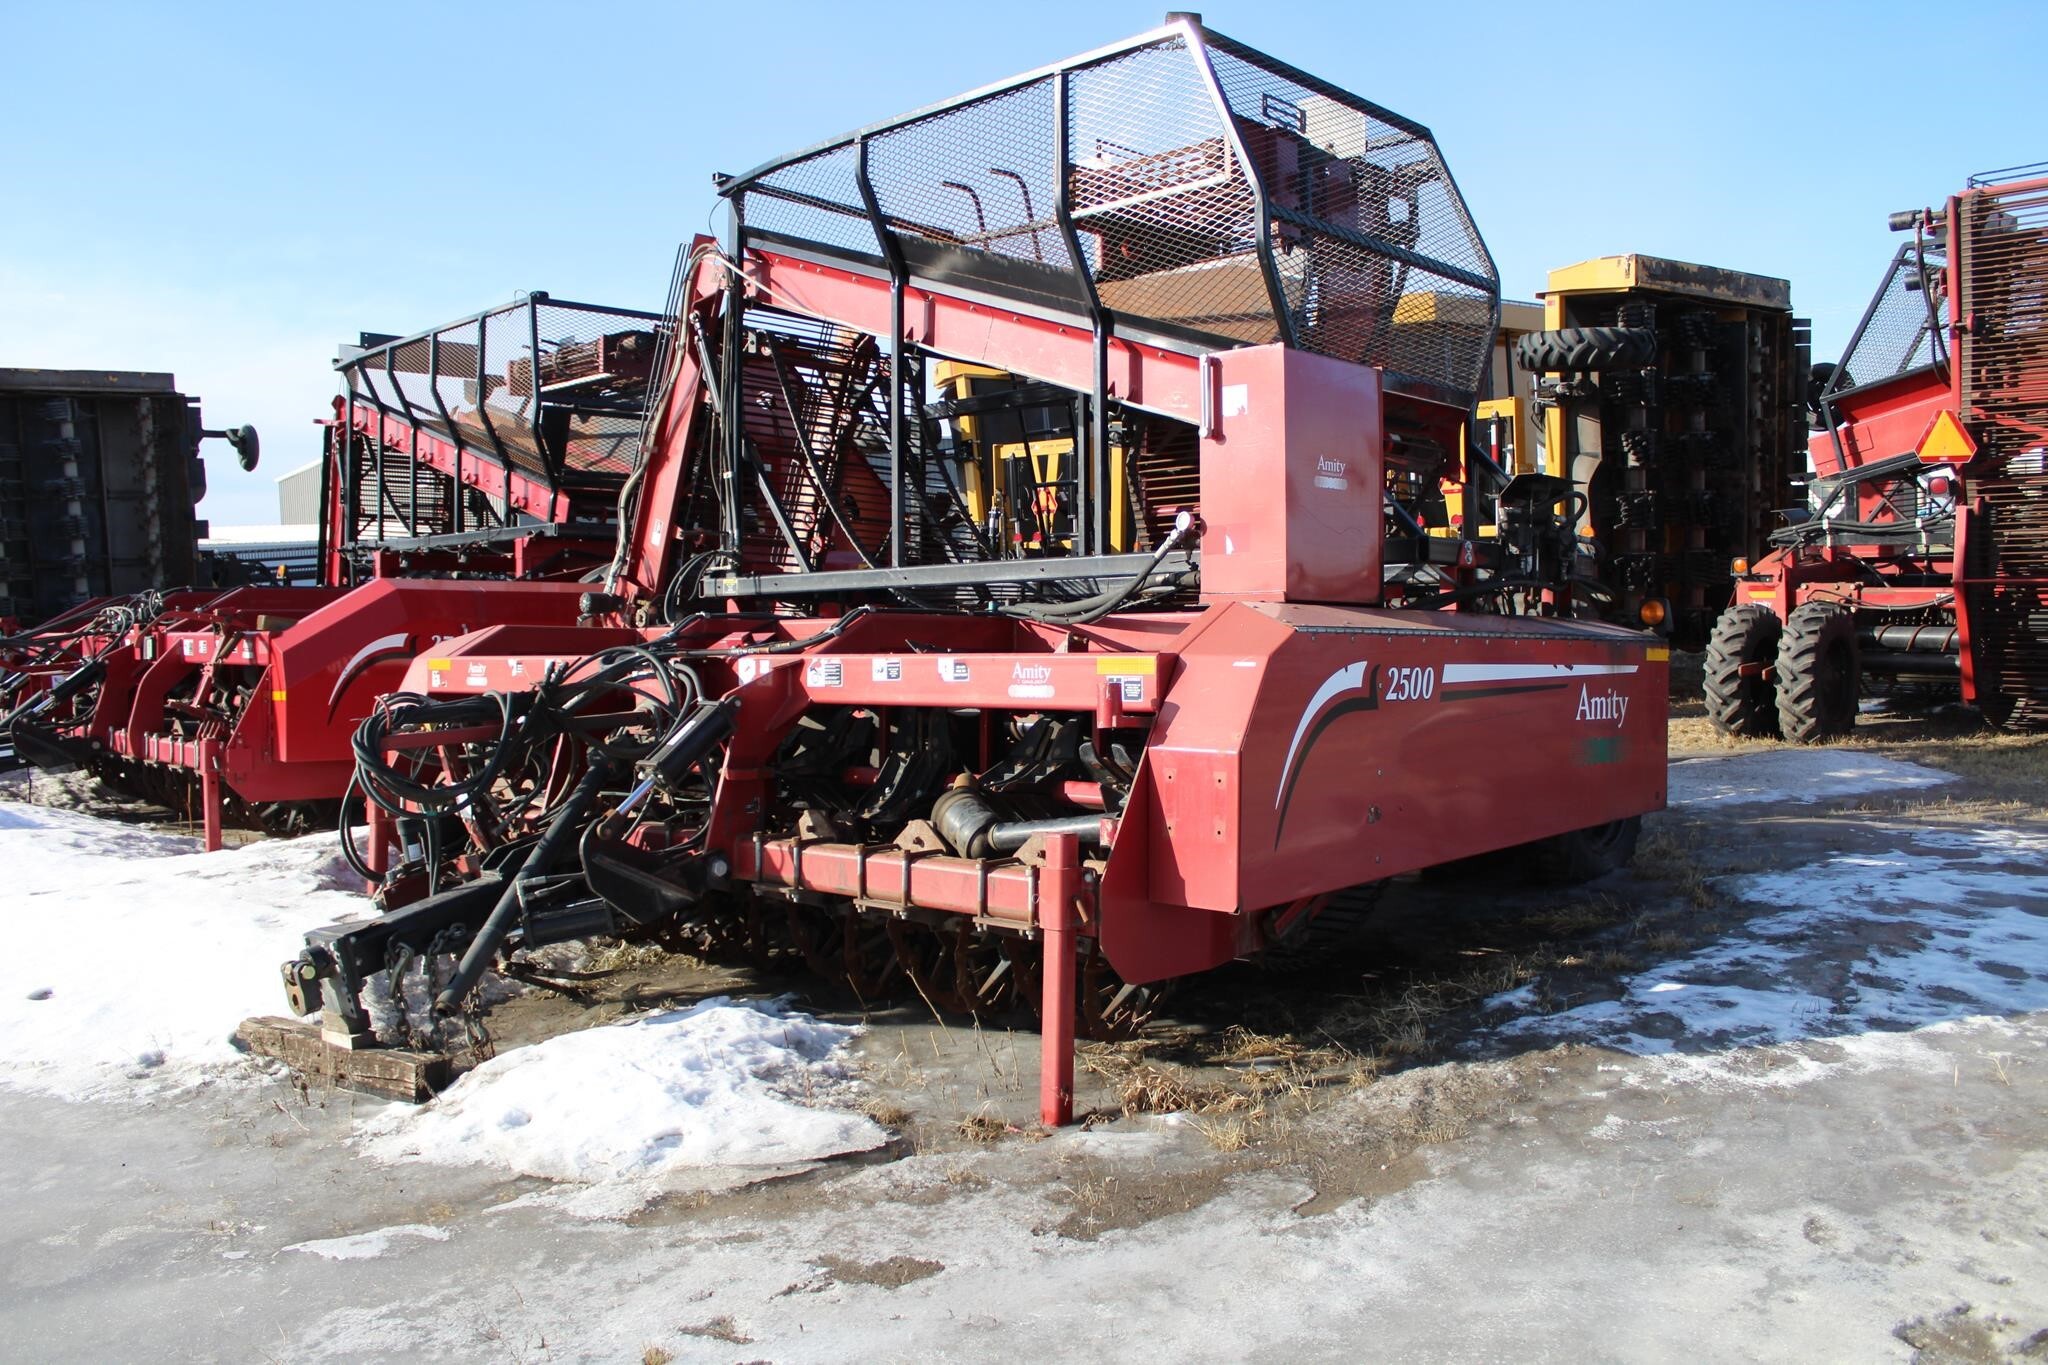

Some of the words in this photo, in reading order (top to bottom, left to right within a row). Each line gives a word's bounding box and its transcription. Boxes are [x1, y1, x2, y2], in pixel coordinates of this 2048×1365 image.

[1317, 455, 1346, 477] Amity
[1012, 661, 1053, 684] Amity
[1386, 666, 1435, 701] 2500
[1575, 683, 1629, 728] Amity
